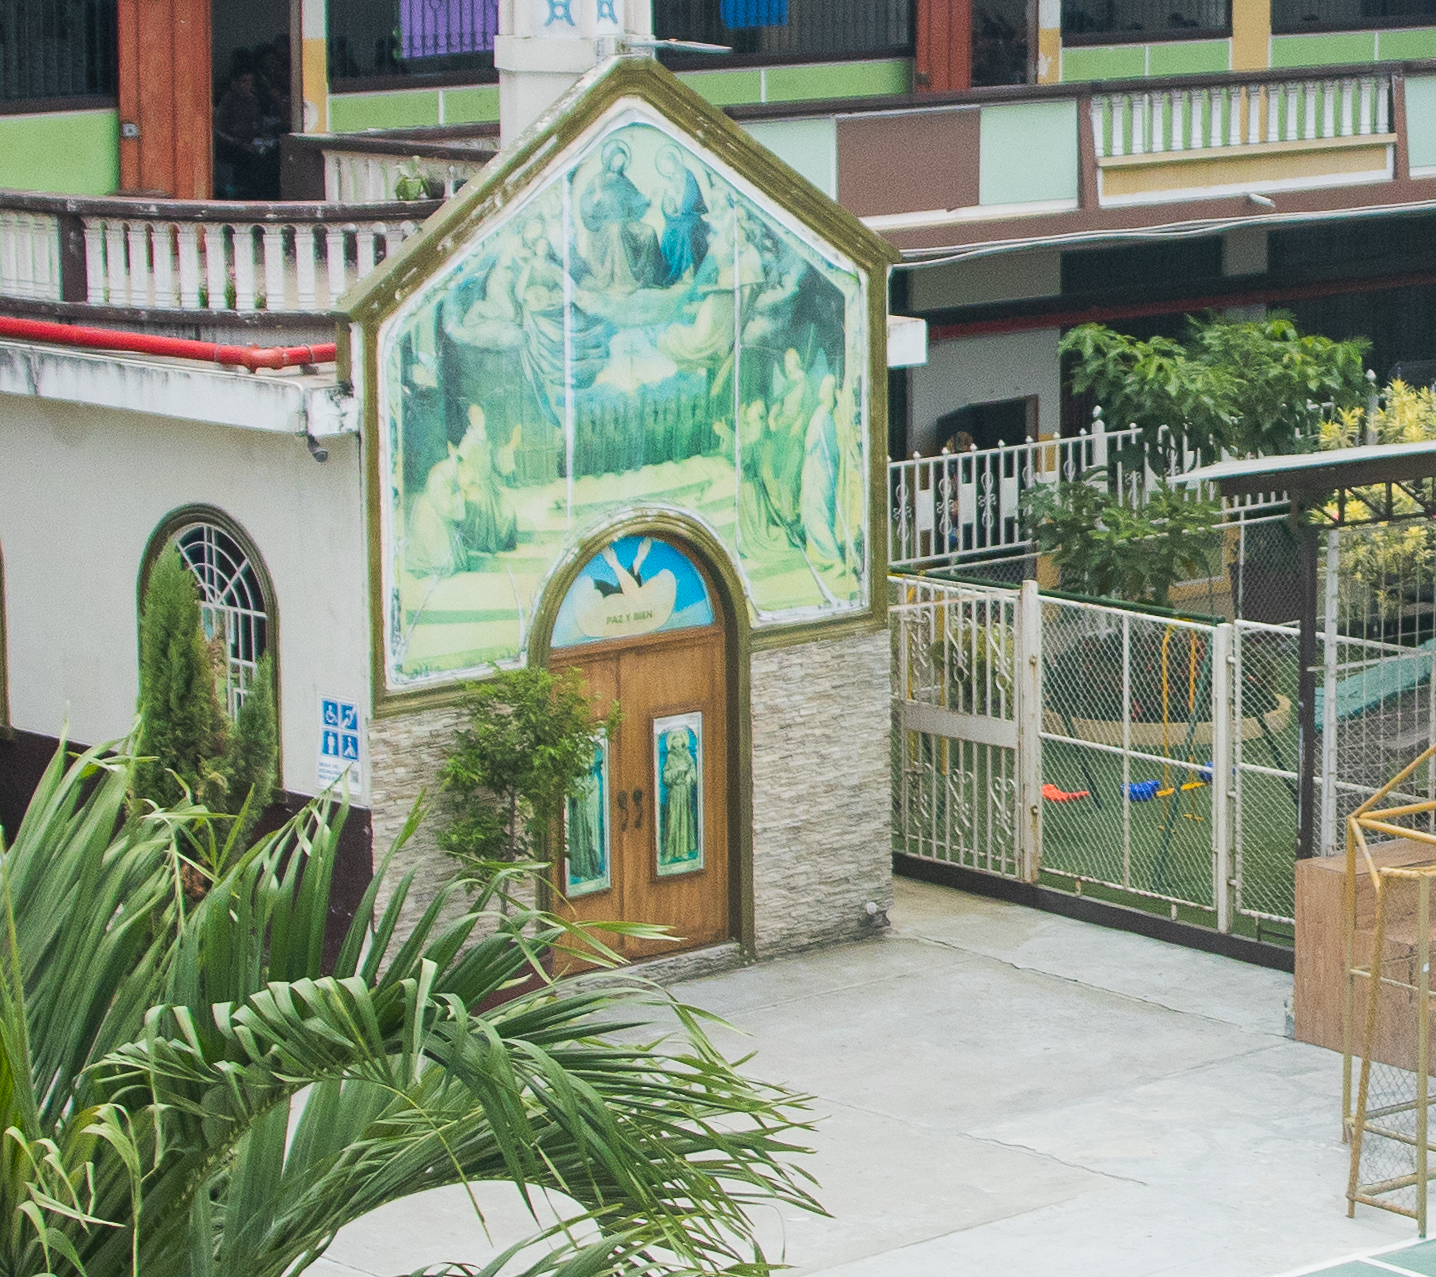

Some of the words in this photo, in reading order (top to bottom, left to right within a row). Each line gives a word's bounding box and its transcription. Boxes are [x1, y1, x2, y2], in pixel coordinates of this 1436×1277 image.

[606, 614, 623, 624] PAZ
[626, 613, 631, 621] Y
[633, 610, 653, 620] BIEN
